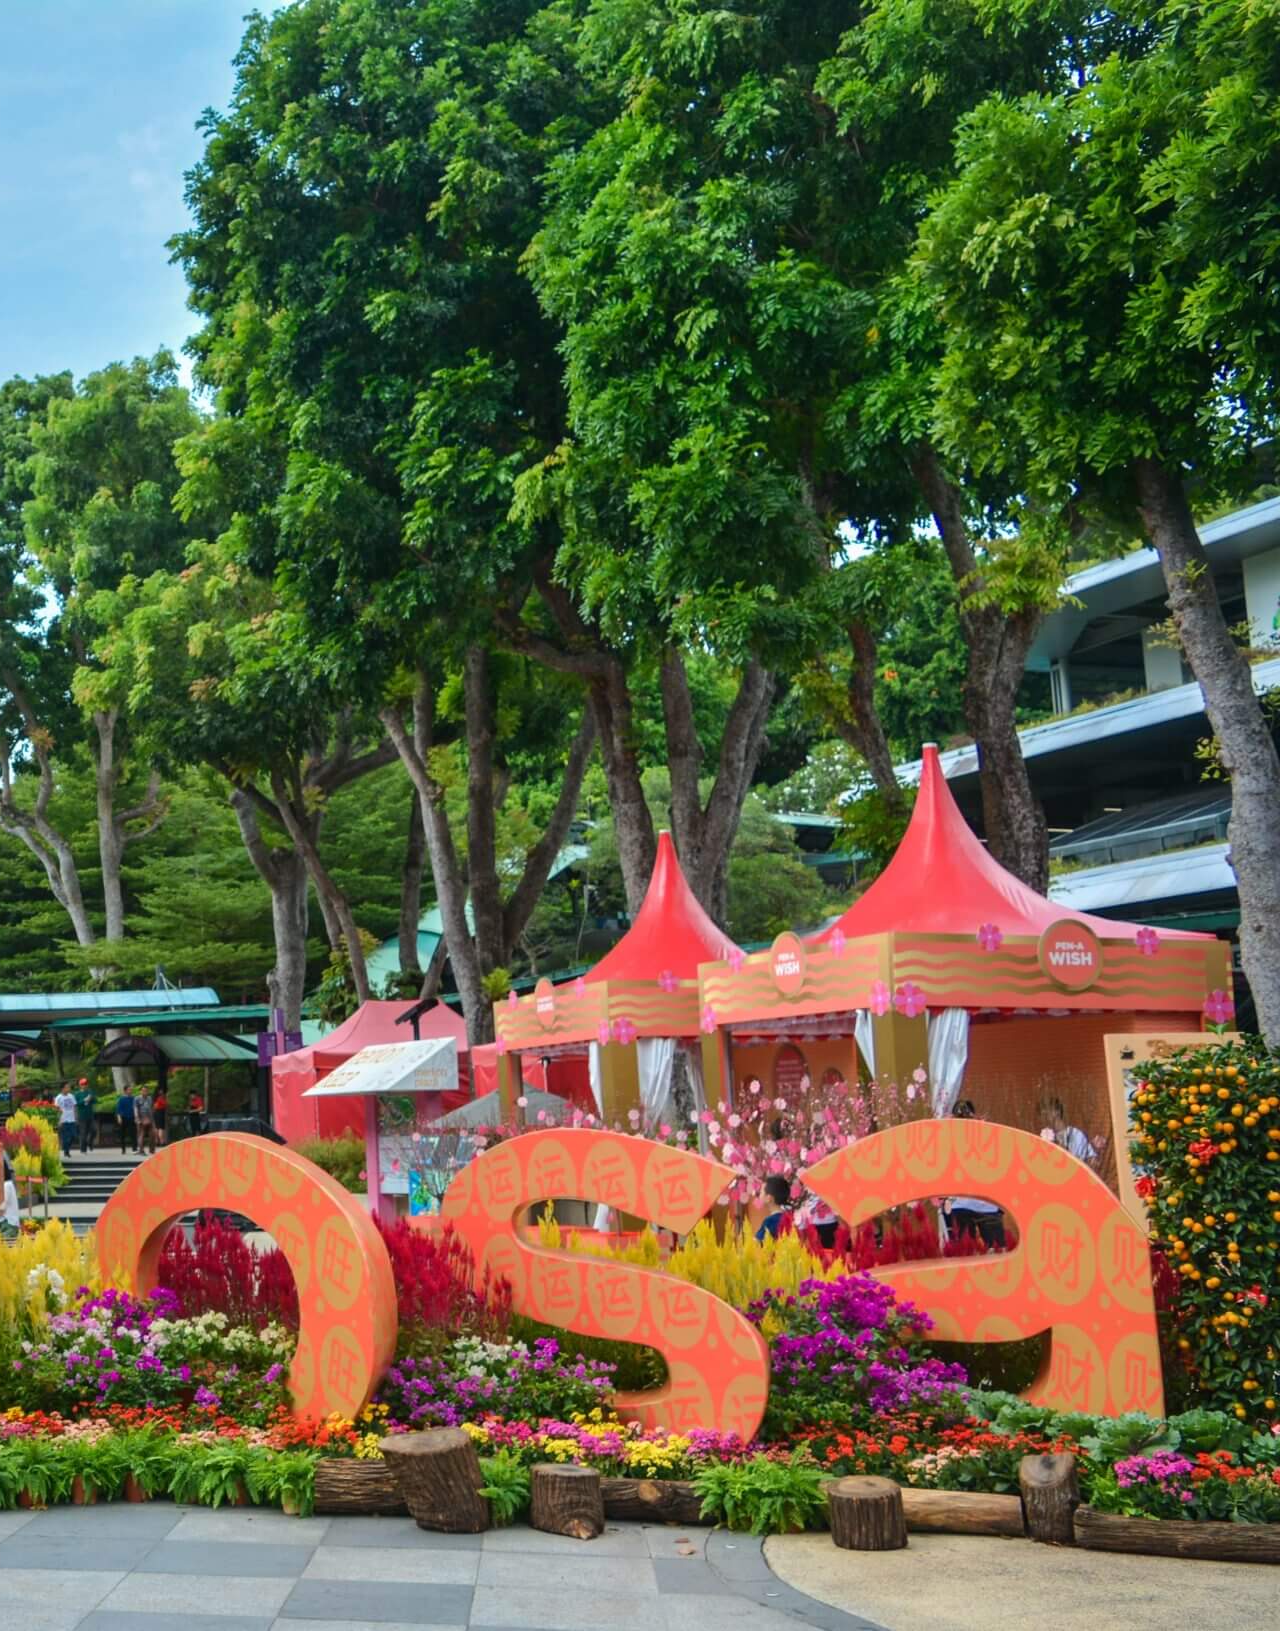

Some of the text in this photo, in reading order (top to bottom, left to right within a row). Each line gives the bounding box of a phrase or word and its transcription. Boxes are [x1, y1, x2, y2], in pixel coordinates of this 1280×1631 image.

[1048, 951, 1093, 966] WISH
[652, 1158, 696, 1217] 运
[322, 1228, 355, 1294] 旺
[1040, 1221, 1084, 1289] 财
[542, 1265, 697, 1328] 运 运 运
[328, 1340, 360, 1402] 旺
[1050, 1342, 1096, 1410] 财
